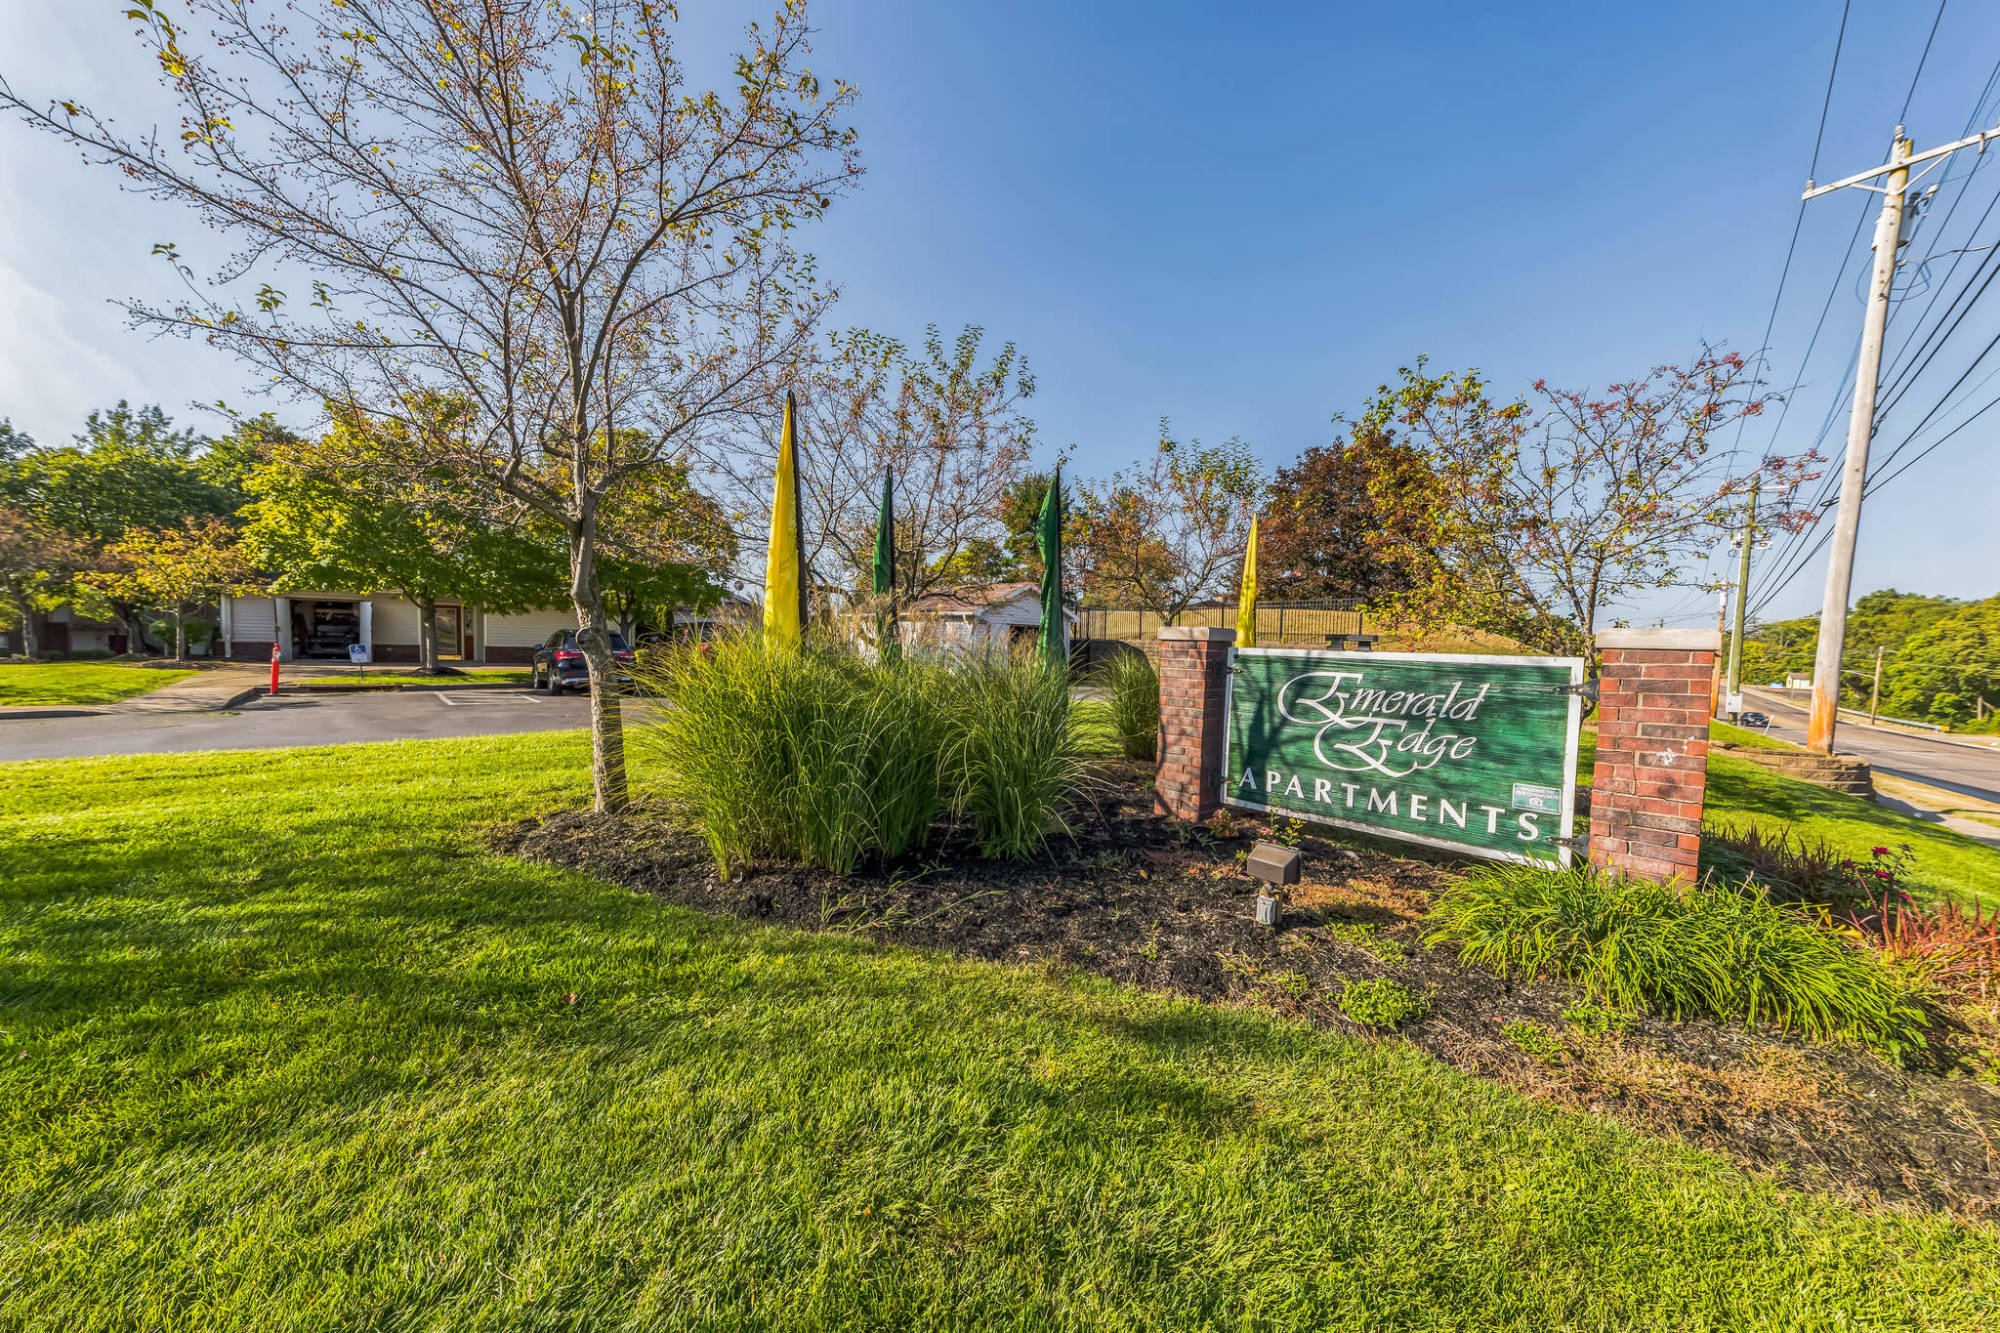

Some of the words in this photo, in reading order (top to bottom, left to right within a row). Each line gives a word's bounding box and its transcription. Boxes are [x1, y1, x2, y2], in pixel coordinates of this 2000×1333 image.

[1278, 671, 1491, 729] Emerald
[1314, 716, 1478, 777] Edge
[1239, 766, 1541, 841] APARTMENTS
